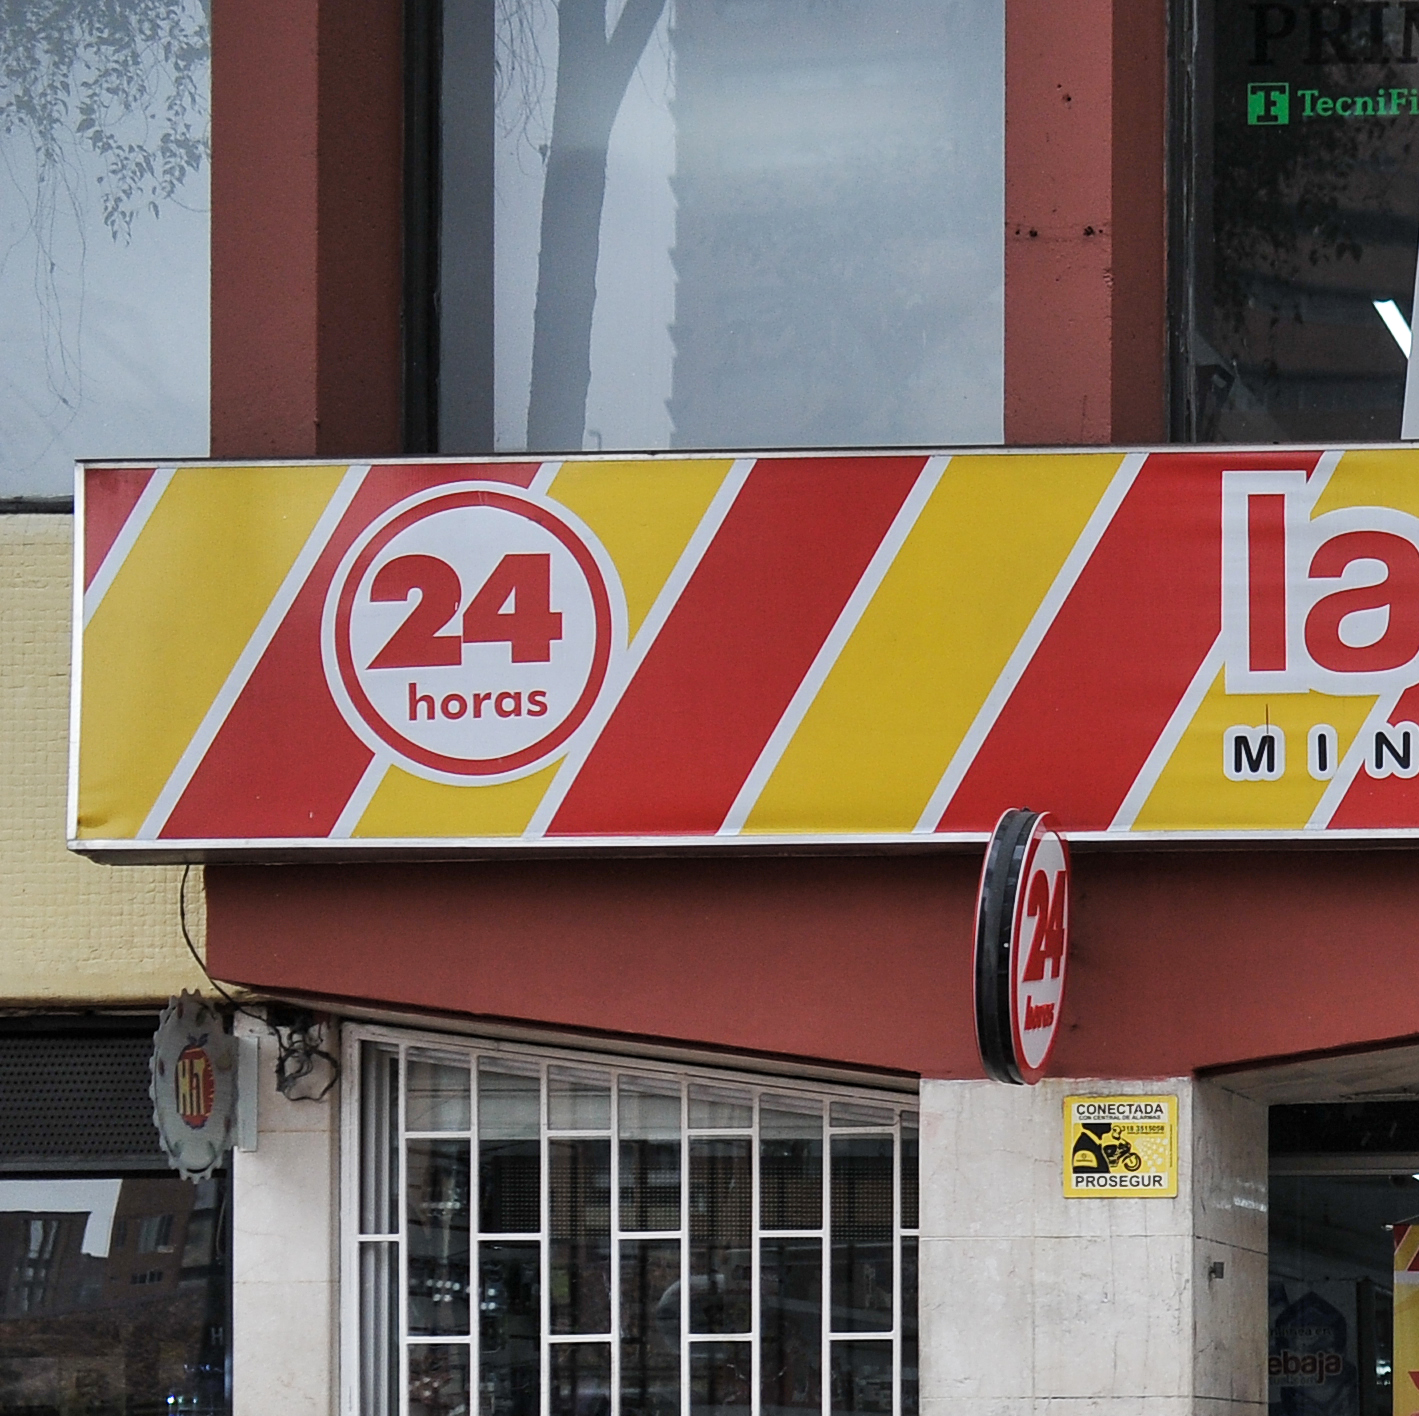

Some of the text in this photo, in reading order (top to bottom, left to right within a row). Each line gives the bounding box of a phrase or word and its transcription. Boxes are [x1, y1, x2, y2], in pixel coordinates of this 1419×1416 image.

[365, 552, 563, 670] 24
[407, 683, 548, 721] horas
[1021, 868, 1066, 983] 24
[1076, 1103, 1164, 1115] CONECTADA
[1075, 1175, 1163, 1187] PROSEGUR
[1269, 1351, 1341, 1384] ebaja
